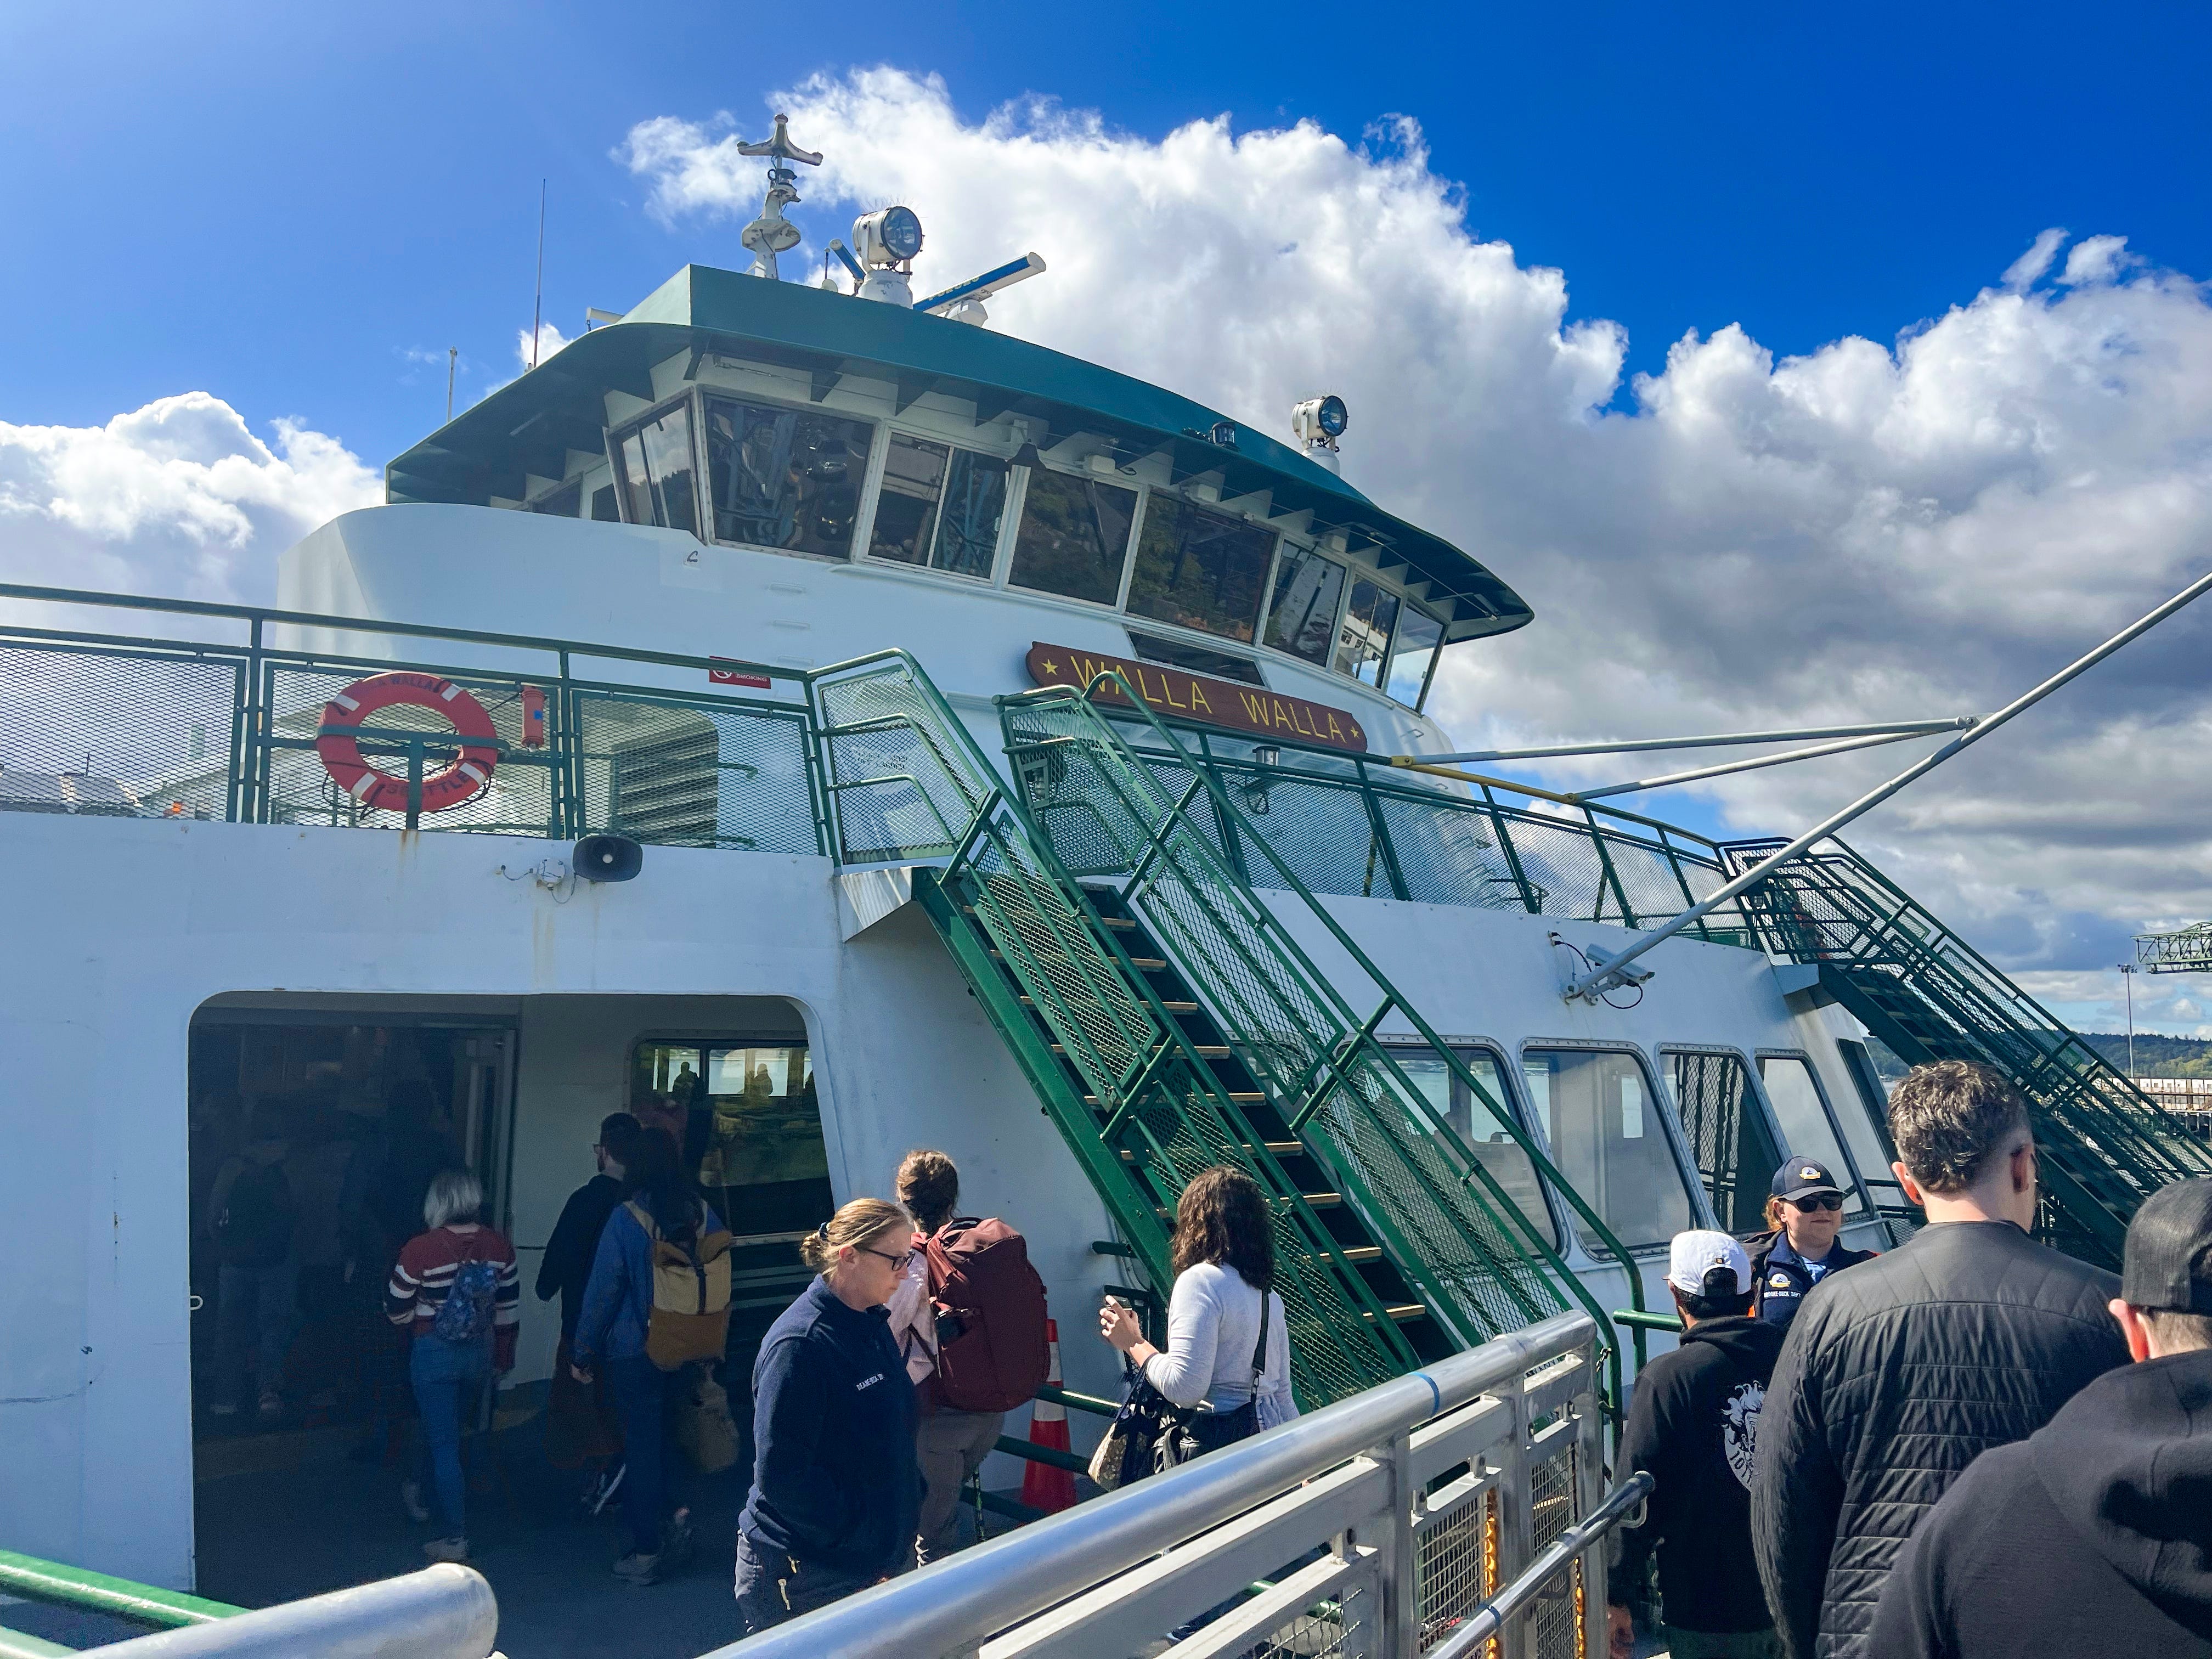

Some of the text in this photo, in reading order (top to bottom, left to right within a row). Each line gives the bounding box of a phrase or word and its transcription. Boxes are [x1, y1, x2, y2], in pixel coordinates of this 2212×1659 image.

[736, 673, 768, 682] SMOKING
[1070, 656, 1347, 743] WALLA WALLA
[386, 772, 471, 795] SETTLE
